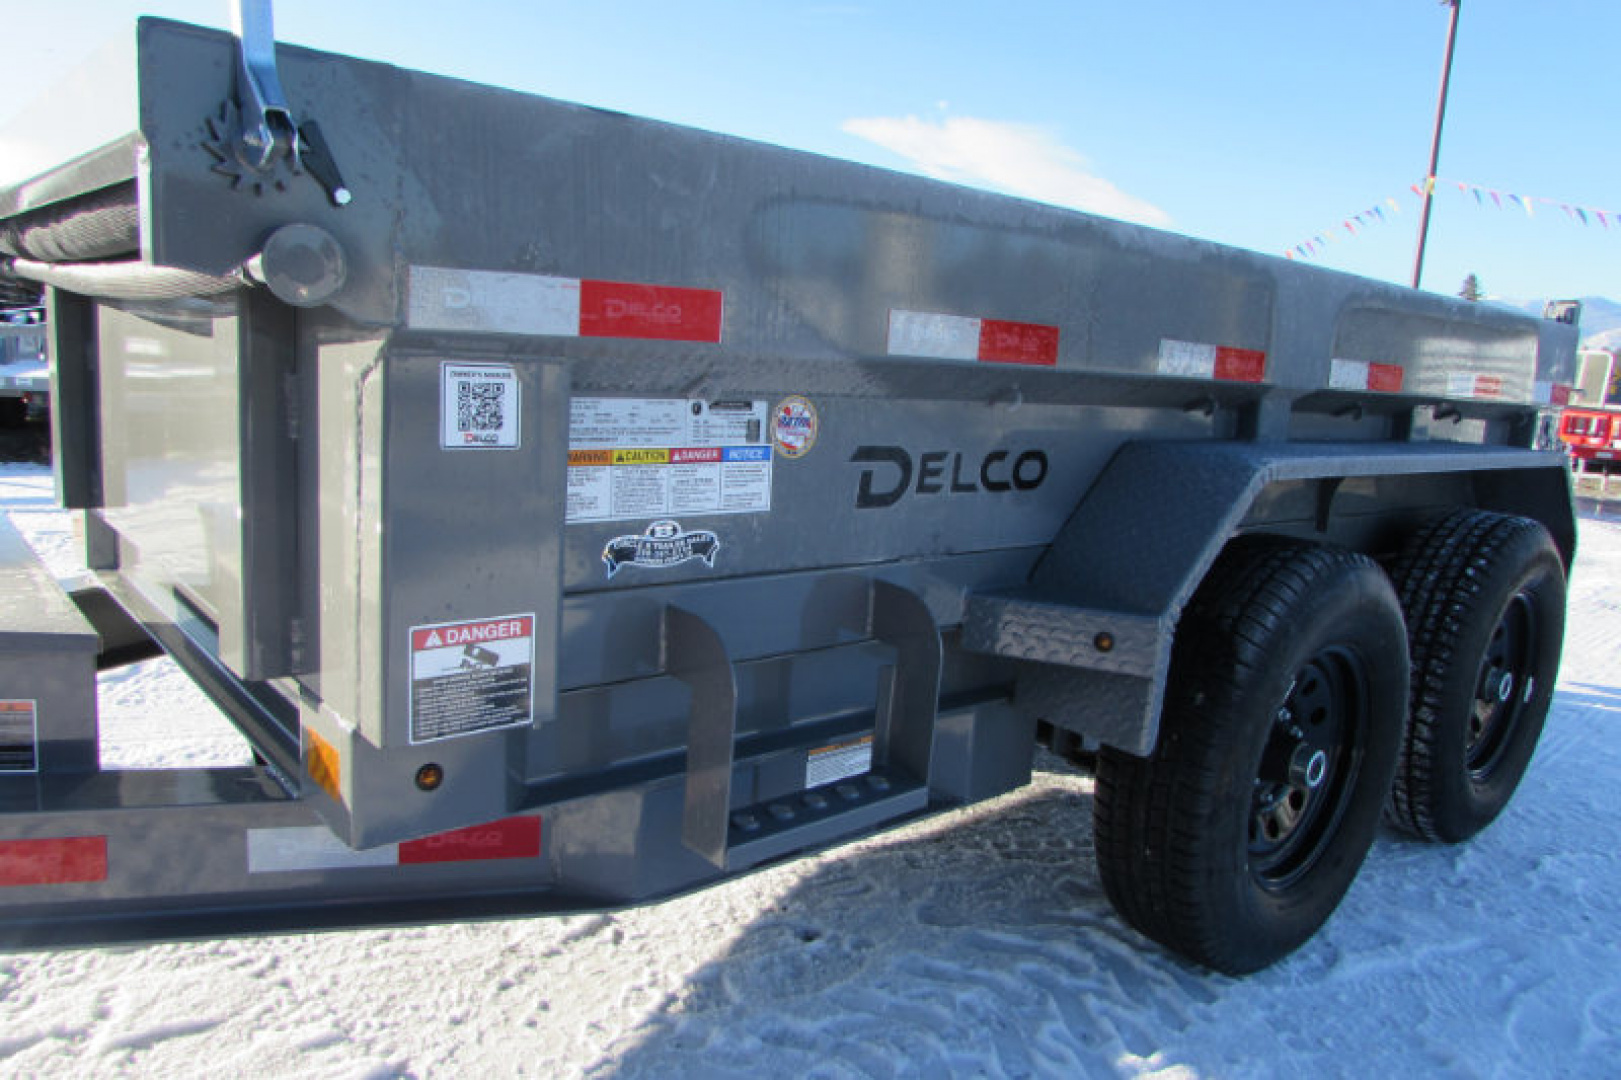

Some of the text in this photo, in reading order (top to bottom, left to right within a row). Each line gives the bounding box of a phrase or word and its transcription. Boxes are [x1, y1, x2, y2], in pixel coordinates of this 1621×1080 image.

[626, 452, 666, 462] CAUTION
[680, 450, 718, 460] DANGER
[729, 449, 764, 460] NOTICE
[850, 446, 1048, 508] DELCO
[446, 621, 522, 643] DANGER
